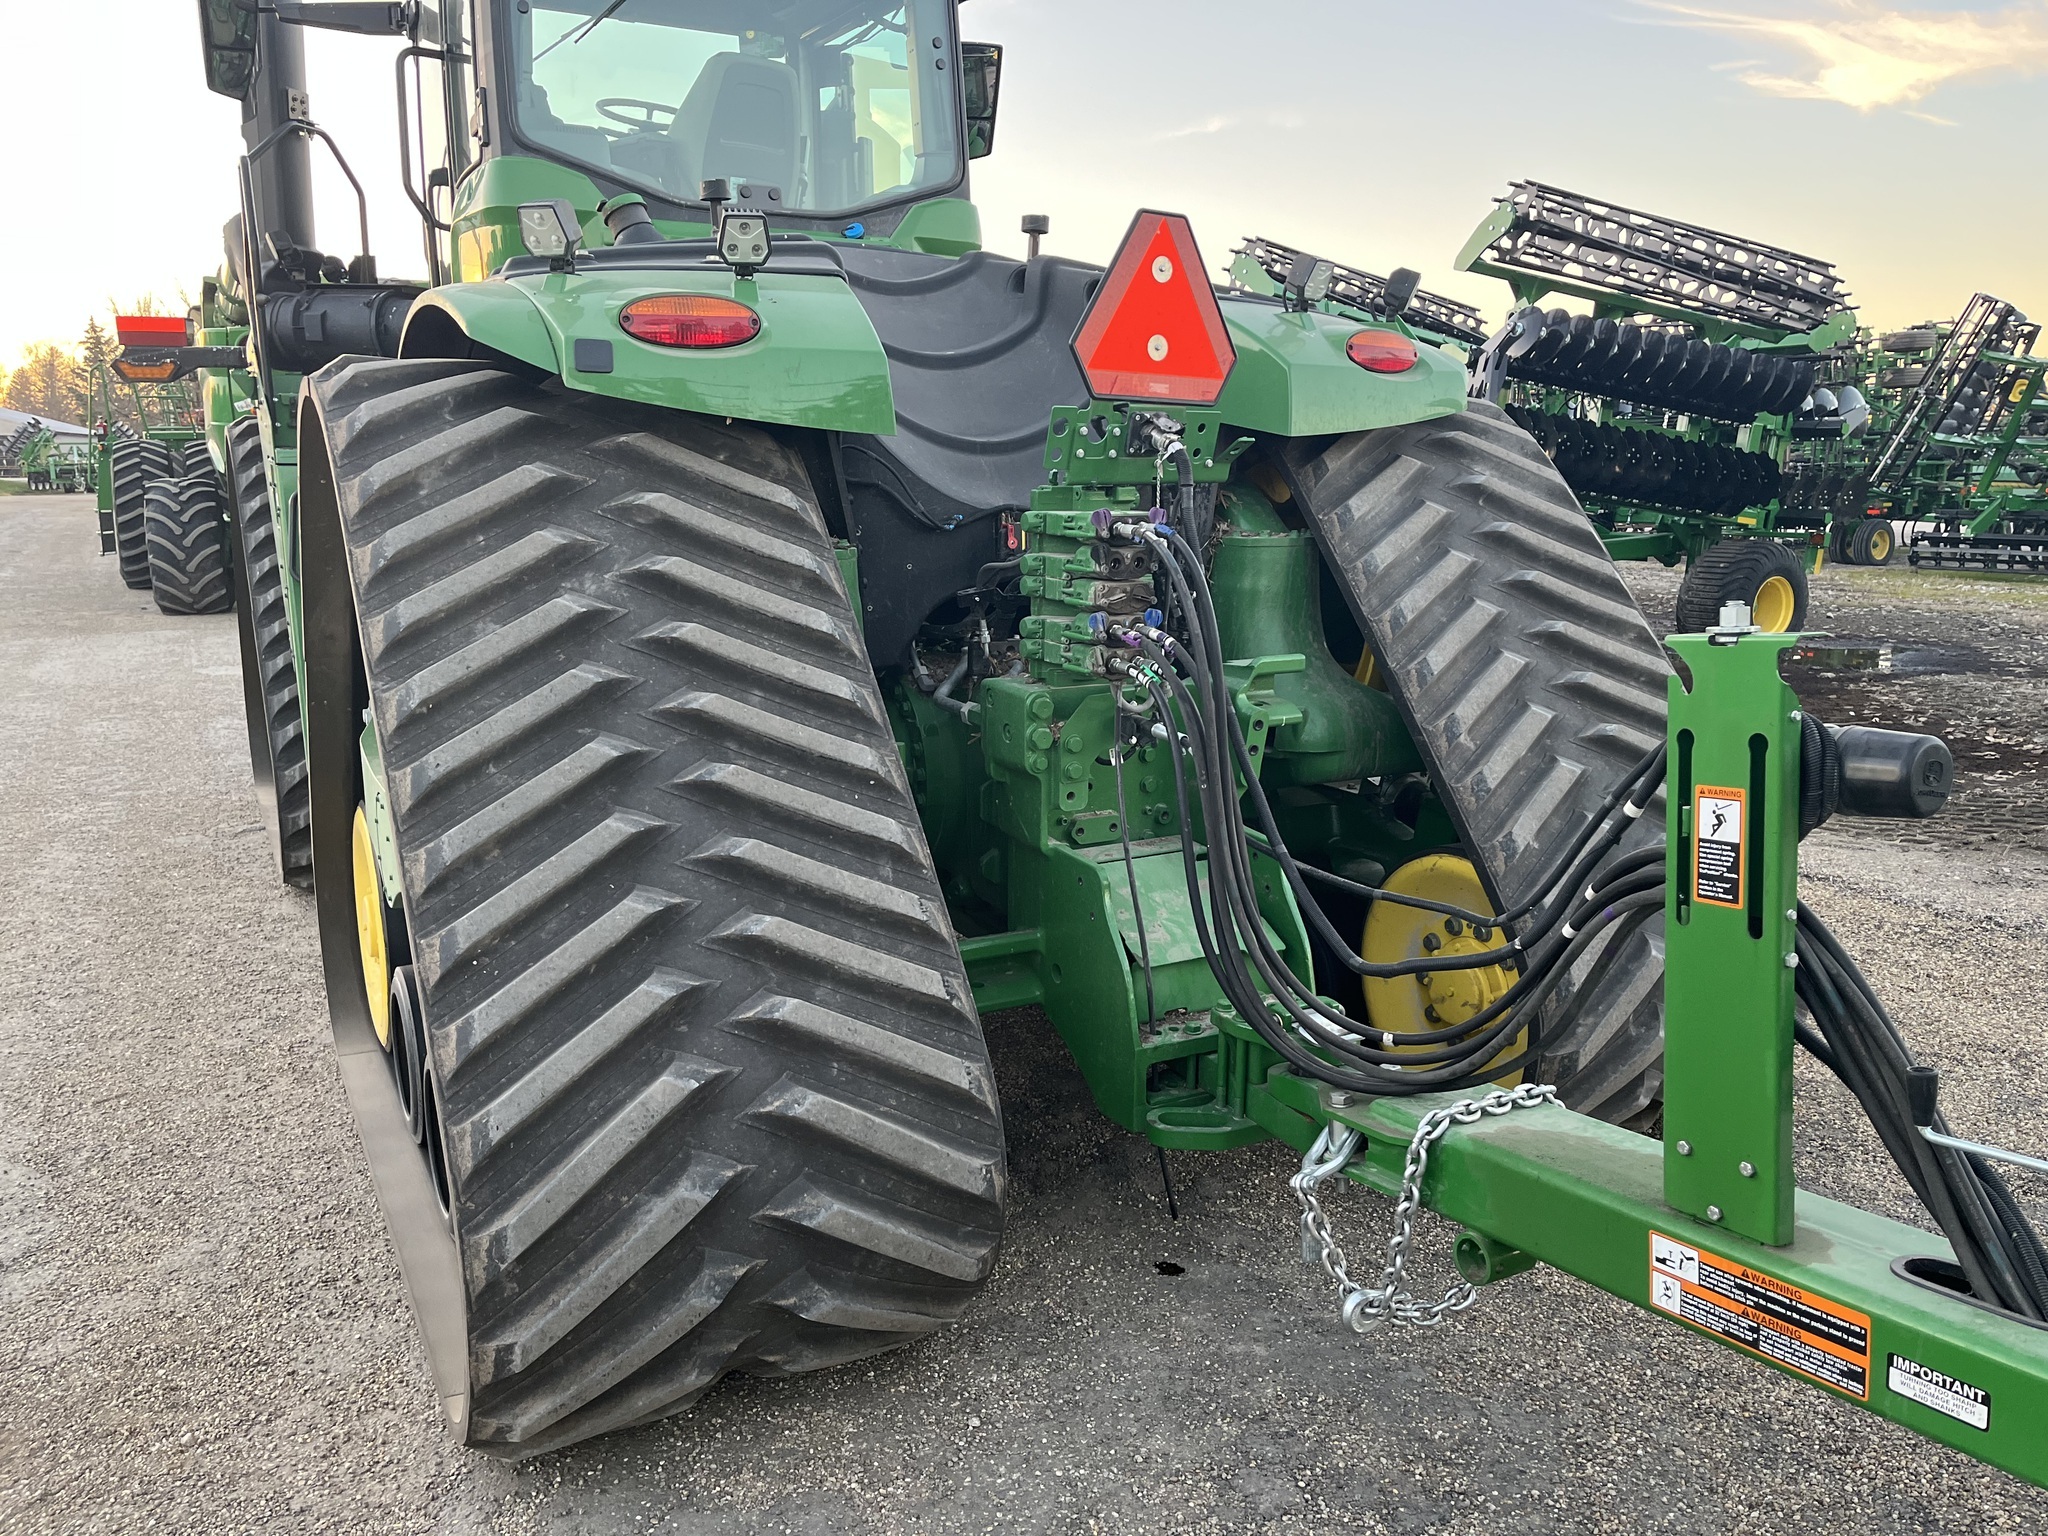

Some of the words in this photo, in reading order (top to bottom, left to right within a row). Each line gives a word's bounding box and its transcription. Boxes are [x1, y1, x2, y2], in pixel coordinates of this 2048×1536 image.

[1708, 788, 1742, 798] WARNING
[1751, 1272, 1802, 1301] WARNING
[1751, 1310, 1802, 1340] WARNING
[1893, 1355, 1985, 1403] IMPORTANT
[1900, 1372, 1931, 1390] TURNING
[1933, 1388, 1949, 1397] TOO
[1951, 1394, 1977, 1408] SHARP
[1900, 1380, 1917, 1391] WILL
[1919, 1388, 1950, 1405] DAMAGE
[1952, 1402, 1976, 1416] HITCH
[1913, 1392, 1929, 1402] AND
[1930, 1399, 1961, 1416] SHANKS
